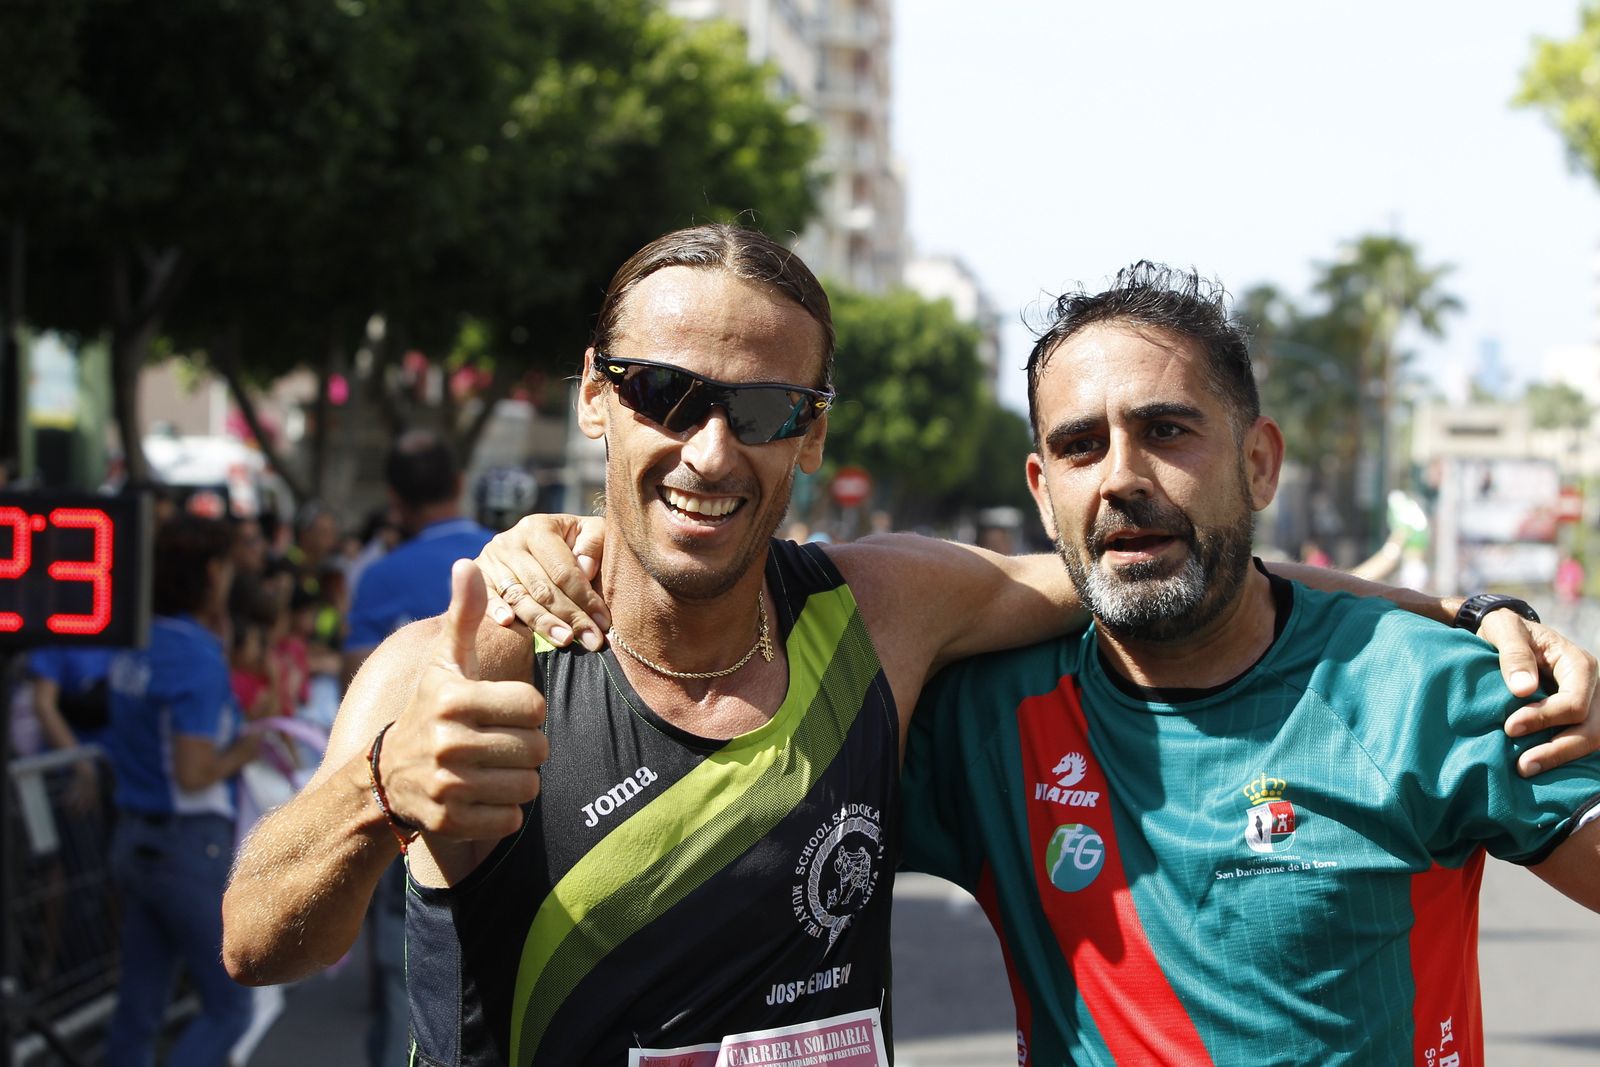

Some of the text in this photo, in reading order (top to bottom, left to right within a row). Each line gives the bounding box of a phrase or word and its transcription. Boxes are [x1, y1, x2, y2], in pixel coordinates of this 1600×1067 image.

[580, 766, 658, 828] Joma
[1034, 783, 1100, 808] VIATOR
[795, 822, 832, 875] SCHOOL
[1215, 870, 1234, 880] San
[1287, 863, 1300, 872] de
[1300, 861, 1311, 870] la
[792, 884, 810, 923] MUAY
[728, 1025, 870, 1067] CARRERA SOLIDARIA
